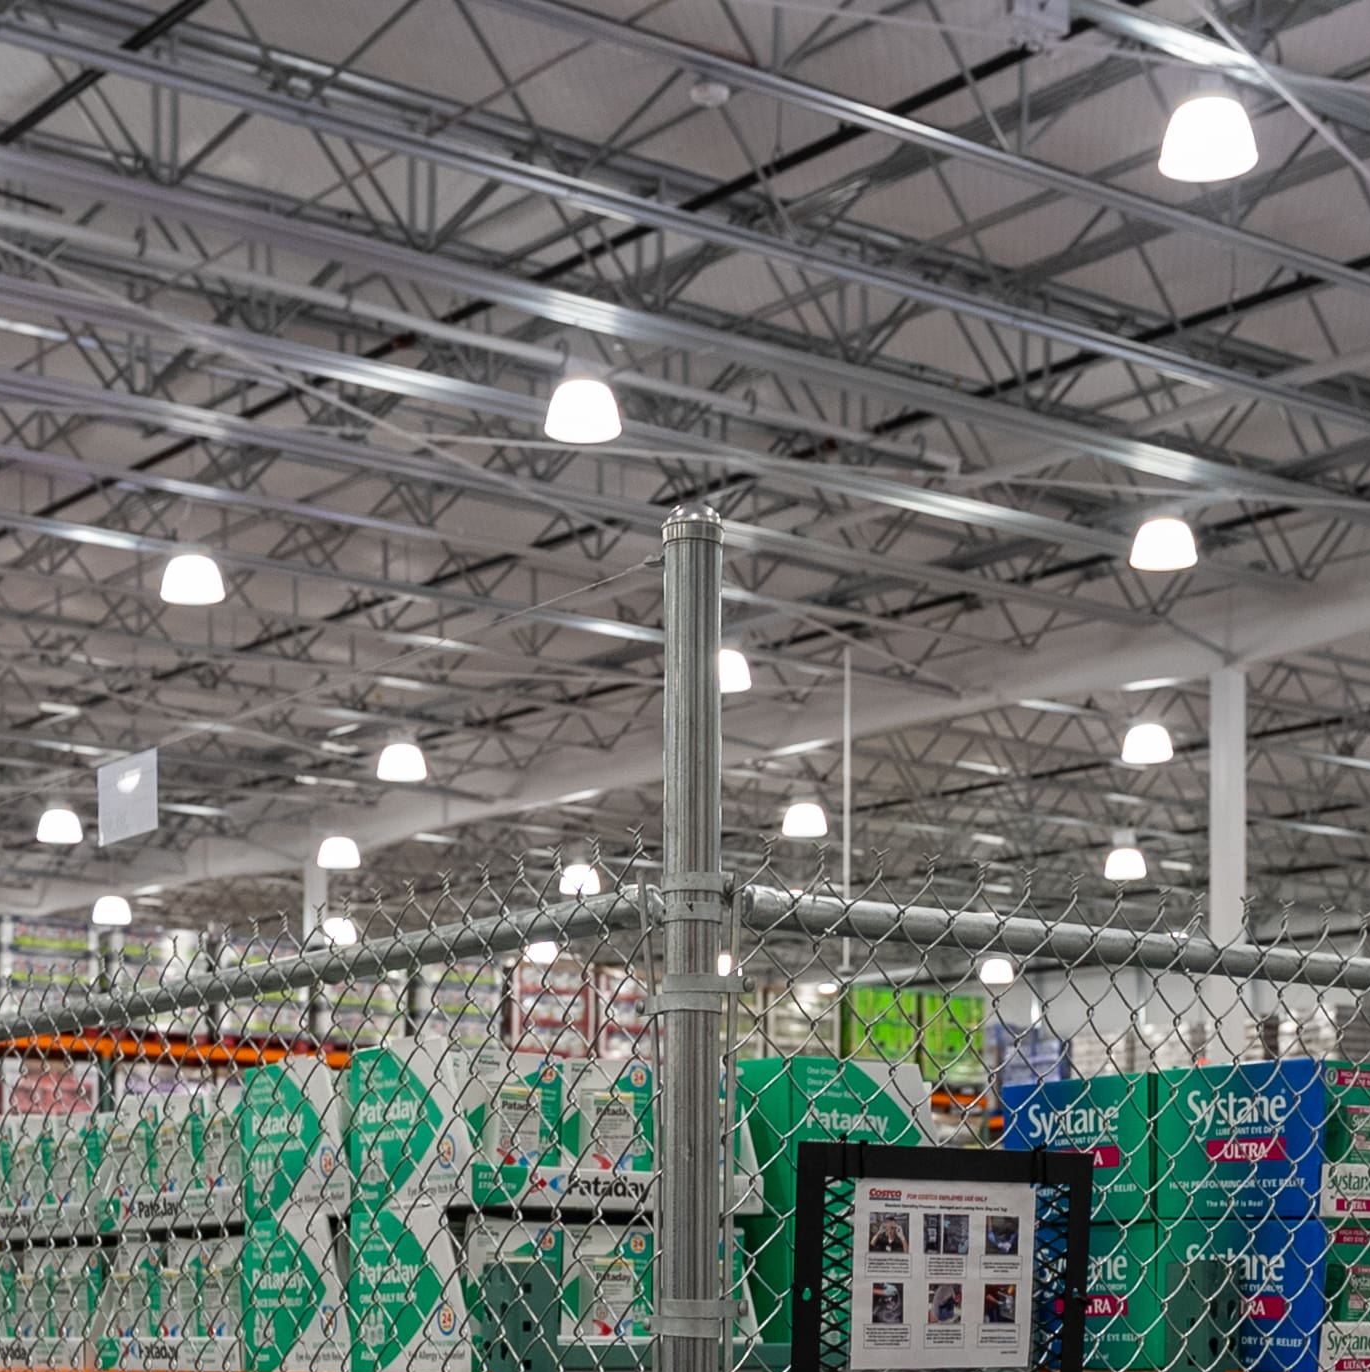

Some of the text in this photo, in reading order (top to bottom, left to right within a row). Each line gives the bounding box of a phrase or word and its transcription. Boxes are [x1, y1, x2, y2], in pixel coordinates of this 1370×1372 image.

[806, 1107, 889, 1132] Pataday
[1028, 1103, 1119, 1147] Systane
[1187, 1089, 1286, 1142] Systane
[1223, 1141, 1268, 1160] ULTRA
[568, 1177, 649, 1203] Pataday
[1276, 1337, 1303, 1348] RELIEF
